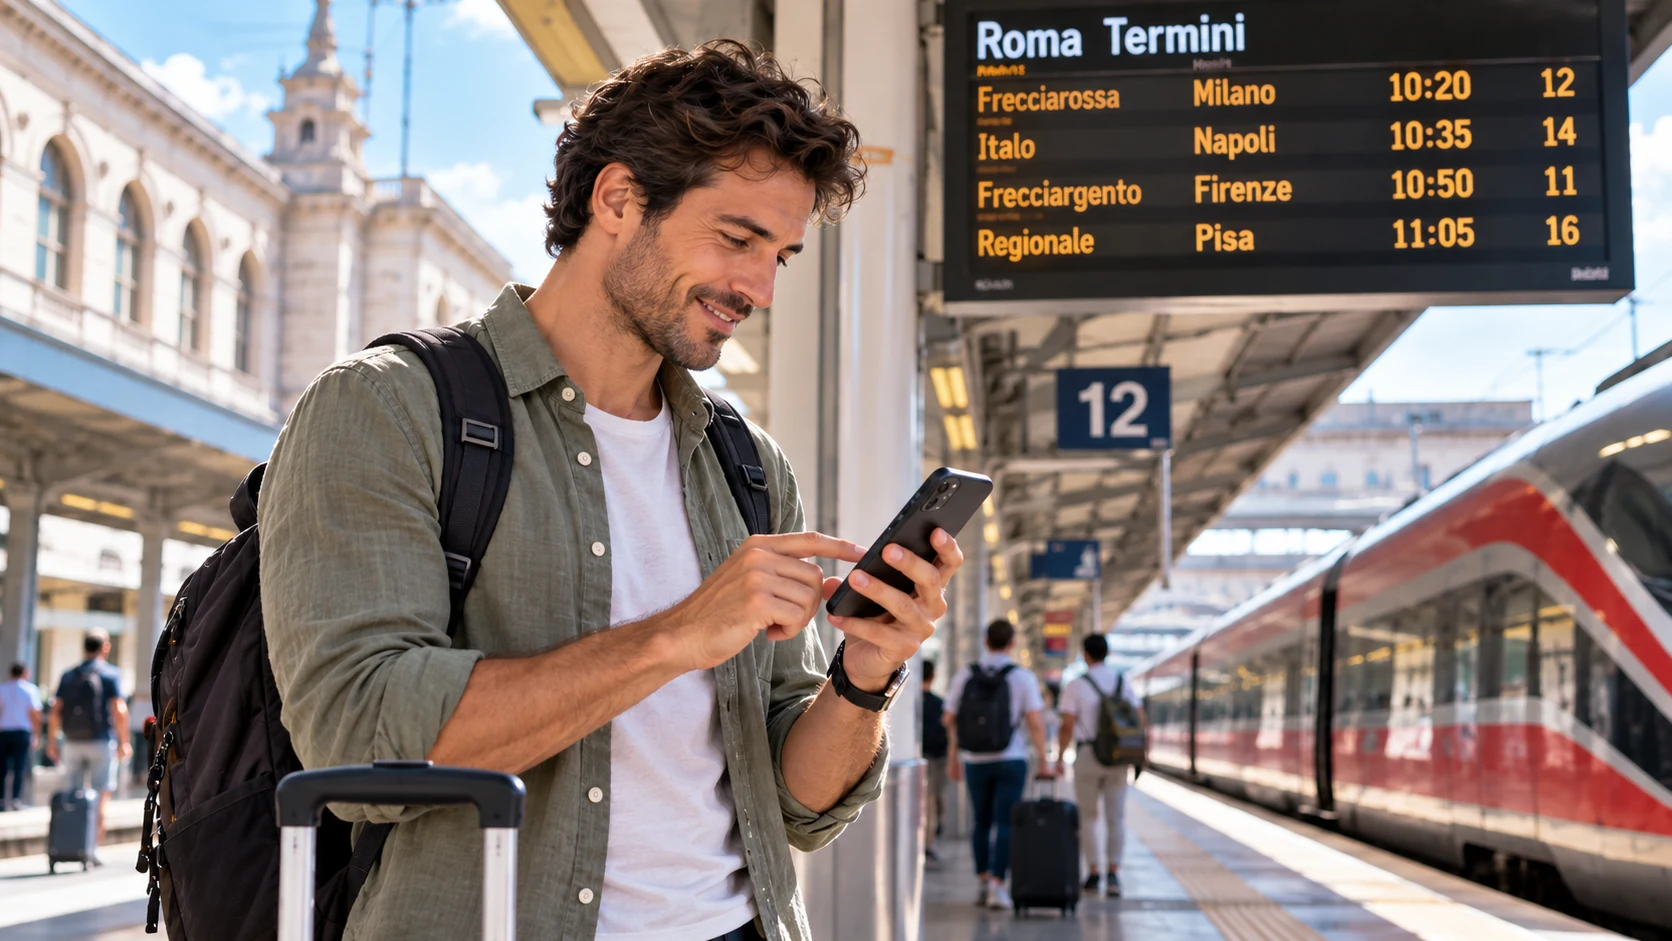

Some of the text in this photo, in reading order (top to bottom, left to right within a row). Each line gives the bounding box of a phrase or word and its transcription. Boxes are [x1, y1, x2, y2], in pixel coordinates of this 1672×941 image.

[978, 13, 1244, 59] Roma Termini
[978, 67, 1575, 112] Frecciarossa Milano 10:20 12
[979, 117, 1576, 160] Italo Napoli 10:35 14
[978, 166, 1577, 212] Frecciargento Firenze 10:50 11
[978, 215, 1579, 262] Regionale Pisa 11:05 16
[1078, 380, 1148, 438] 12
